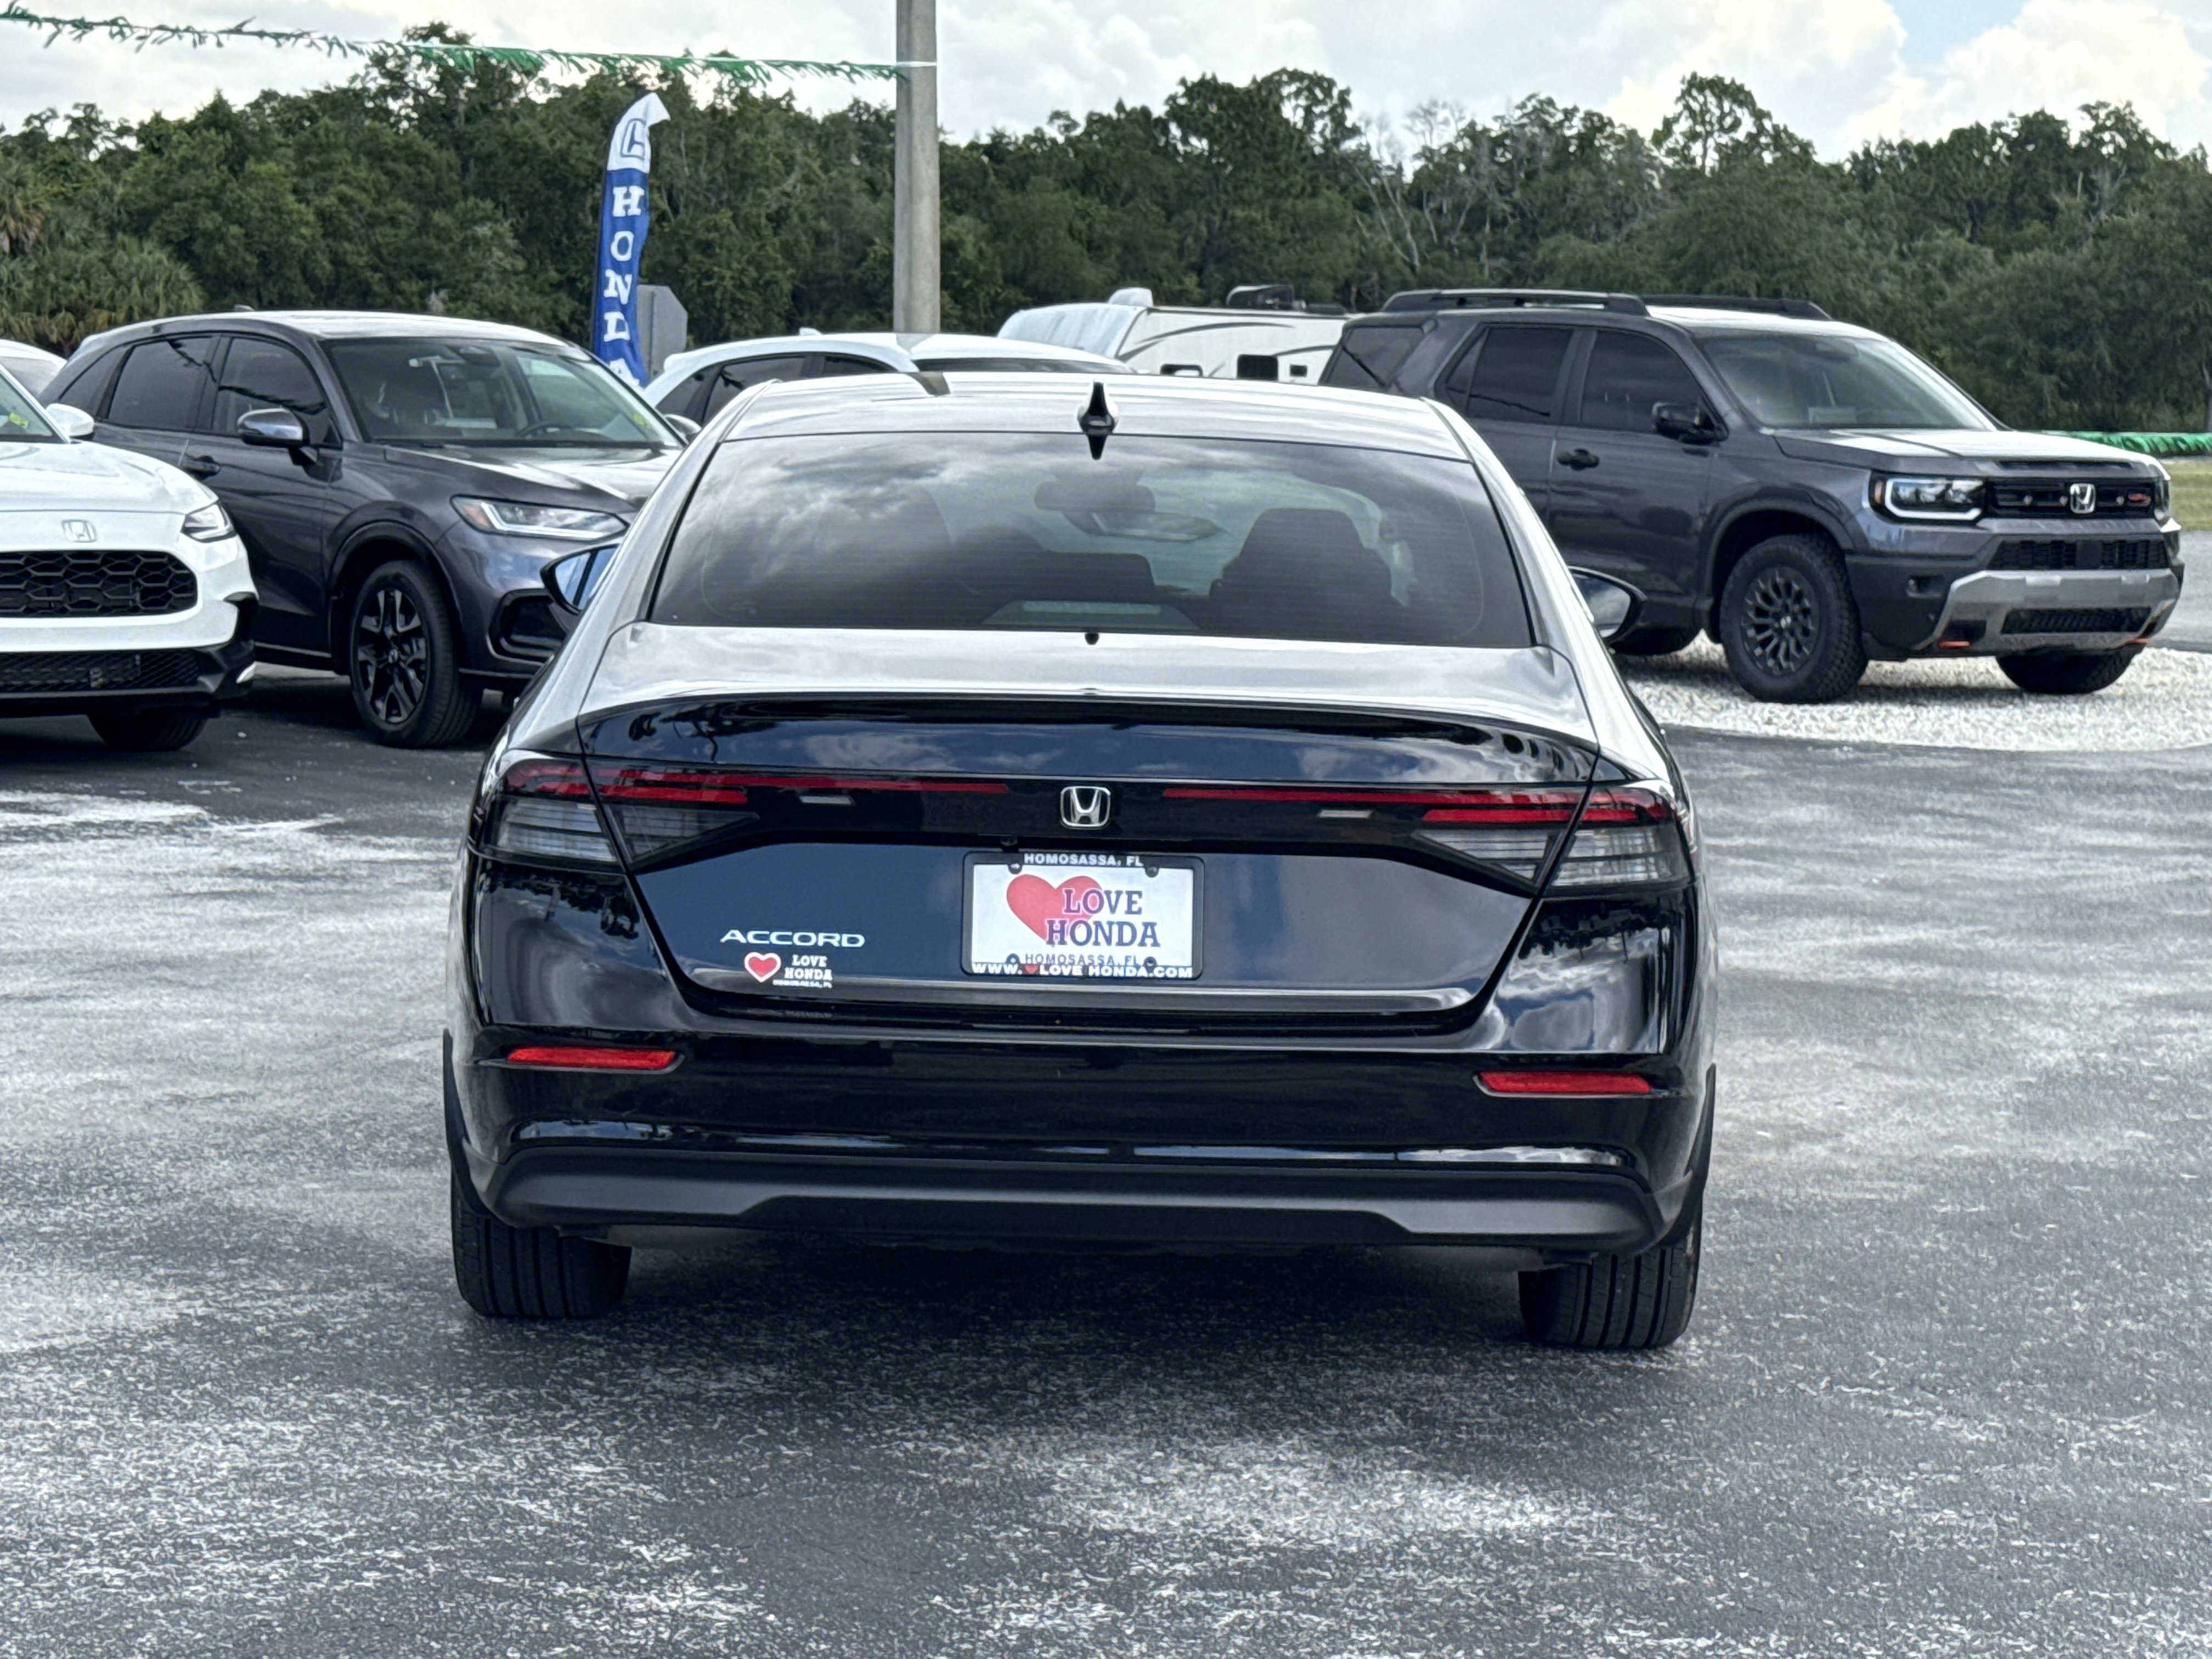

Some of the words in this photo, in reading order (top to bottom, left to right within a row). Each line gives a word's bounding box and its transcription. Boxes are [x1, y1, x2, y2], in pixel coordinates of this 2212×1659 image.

[604, 185, 645, 386] HONDA
[1024, 853, 1121, 866] HOMOSASSA,
[1126, 856, 1144, 867] FL
[1063, 889, 1143, 915] LOVE
[720, 929, 865, 947] ACCORD
[1046, 918, 1161, 947] HONDA
[792, 954, 827, 967] LOVE
[785, 967, 833, 980] HONDA
